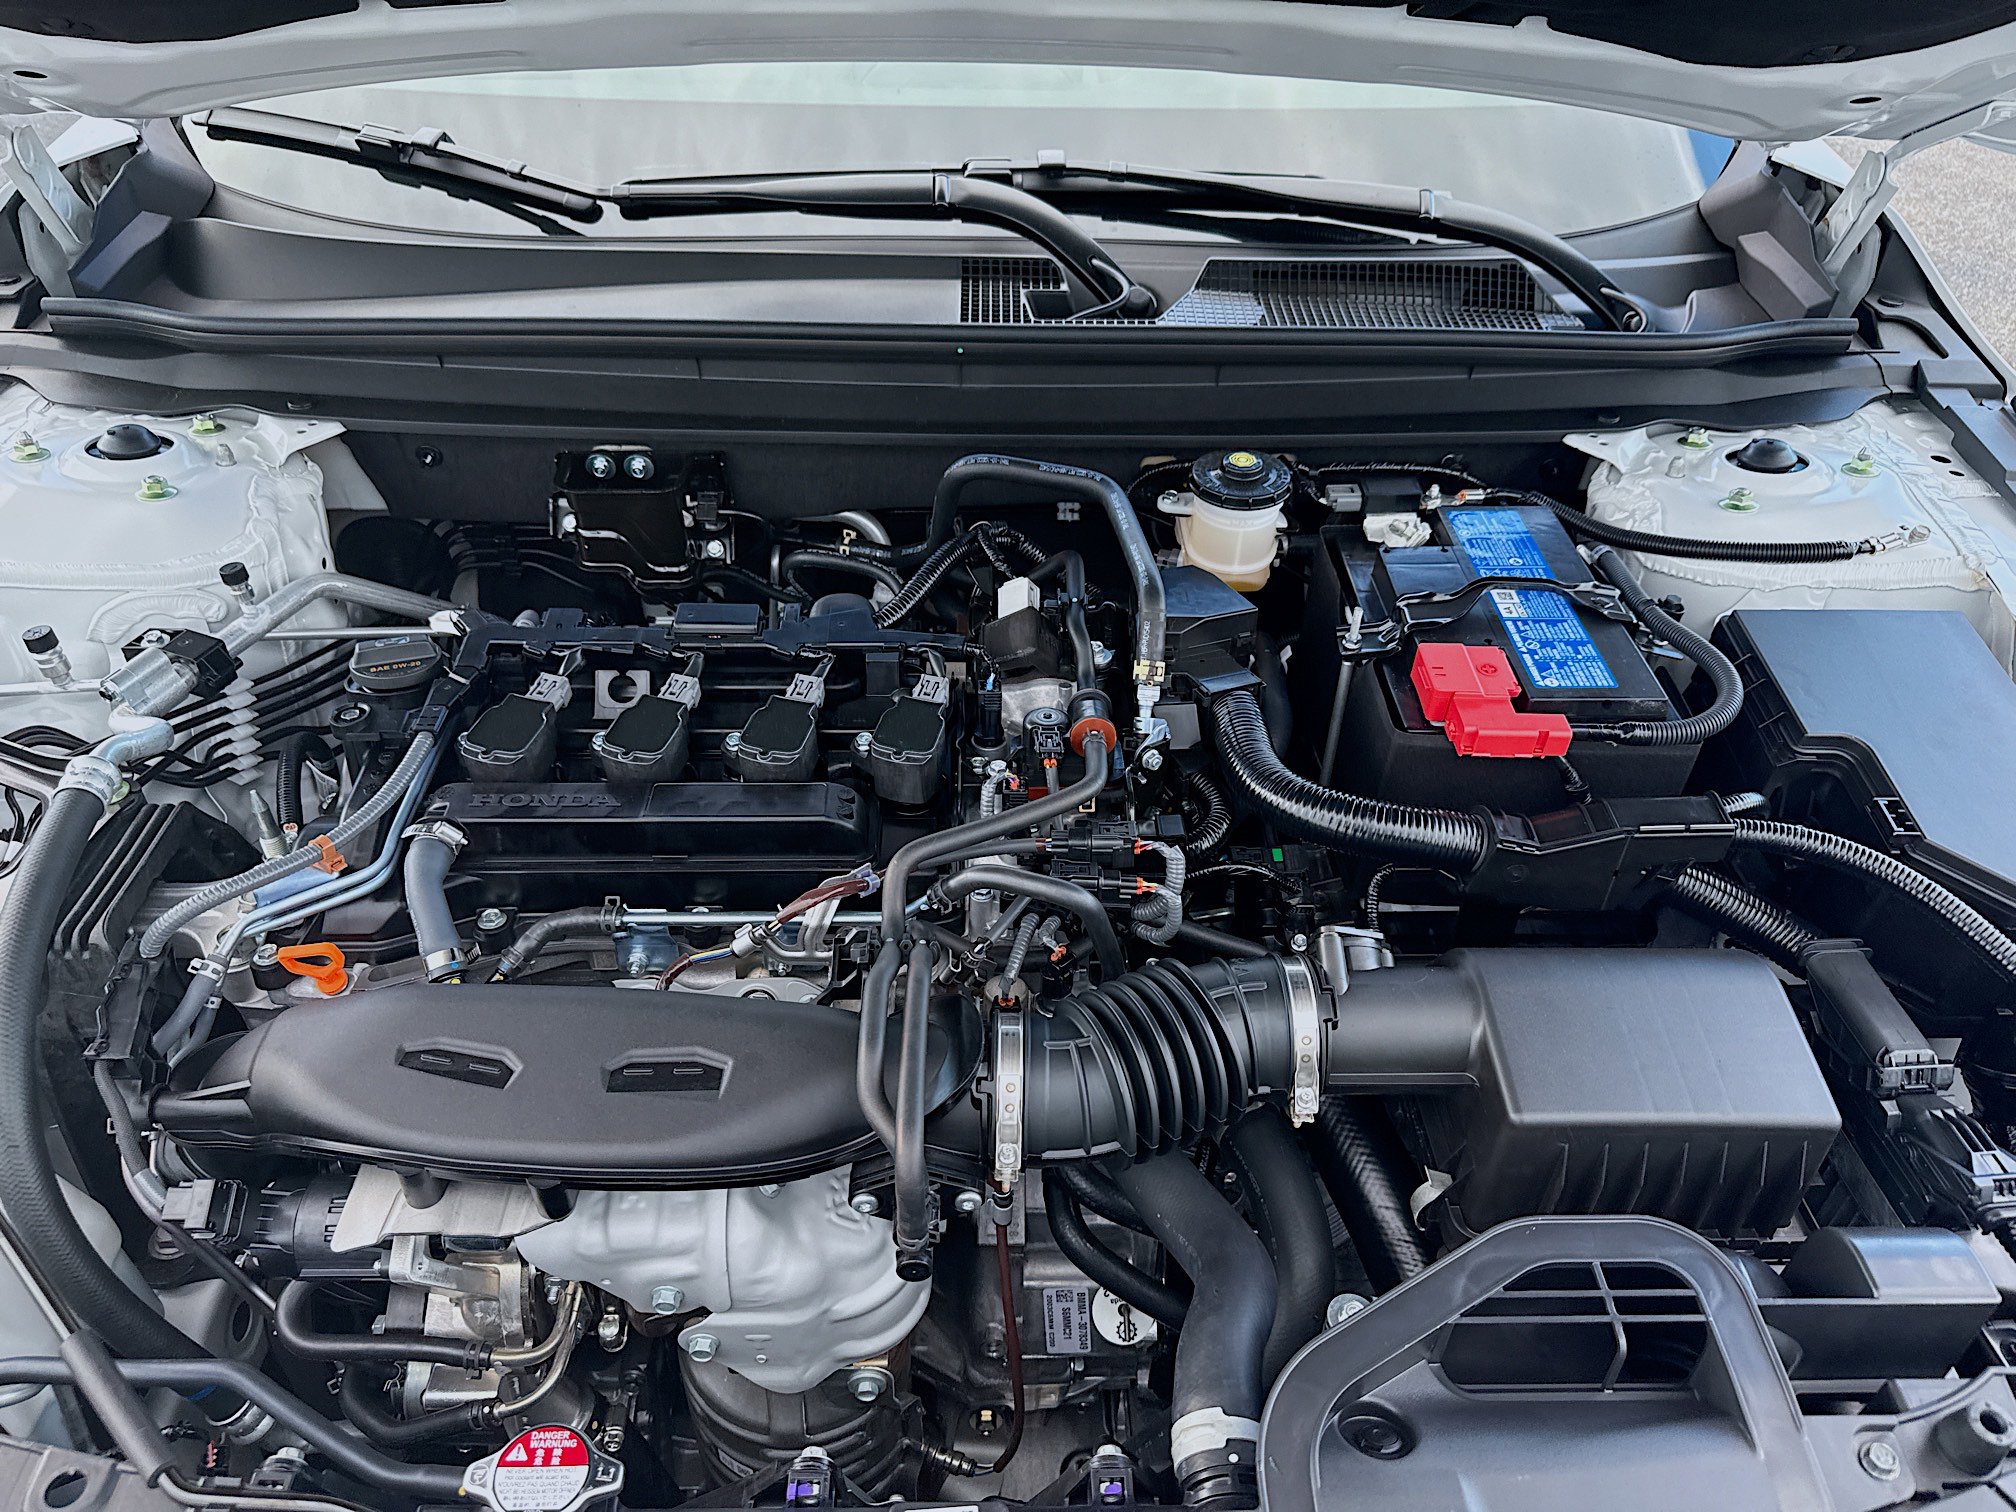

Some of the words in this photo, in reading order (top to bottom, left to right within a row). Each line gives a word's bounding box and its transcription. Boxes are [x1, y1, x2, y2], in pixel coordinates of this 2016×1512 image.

[370, 665, 390, 673] SAE
[392, 661, 421, 669] 0W-20
[468, 793, 622, 807] HONDA
[531, 1431, 570, 1439] DANGER
[530, 1439, 577, 1449] WARNUNG
